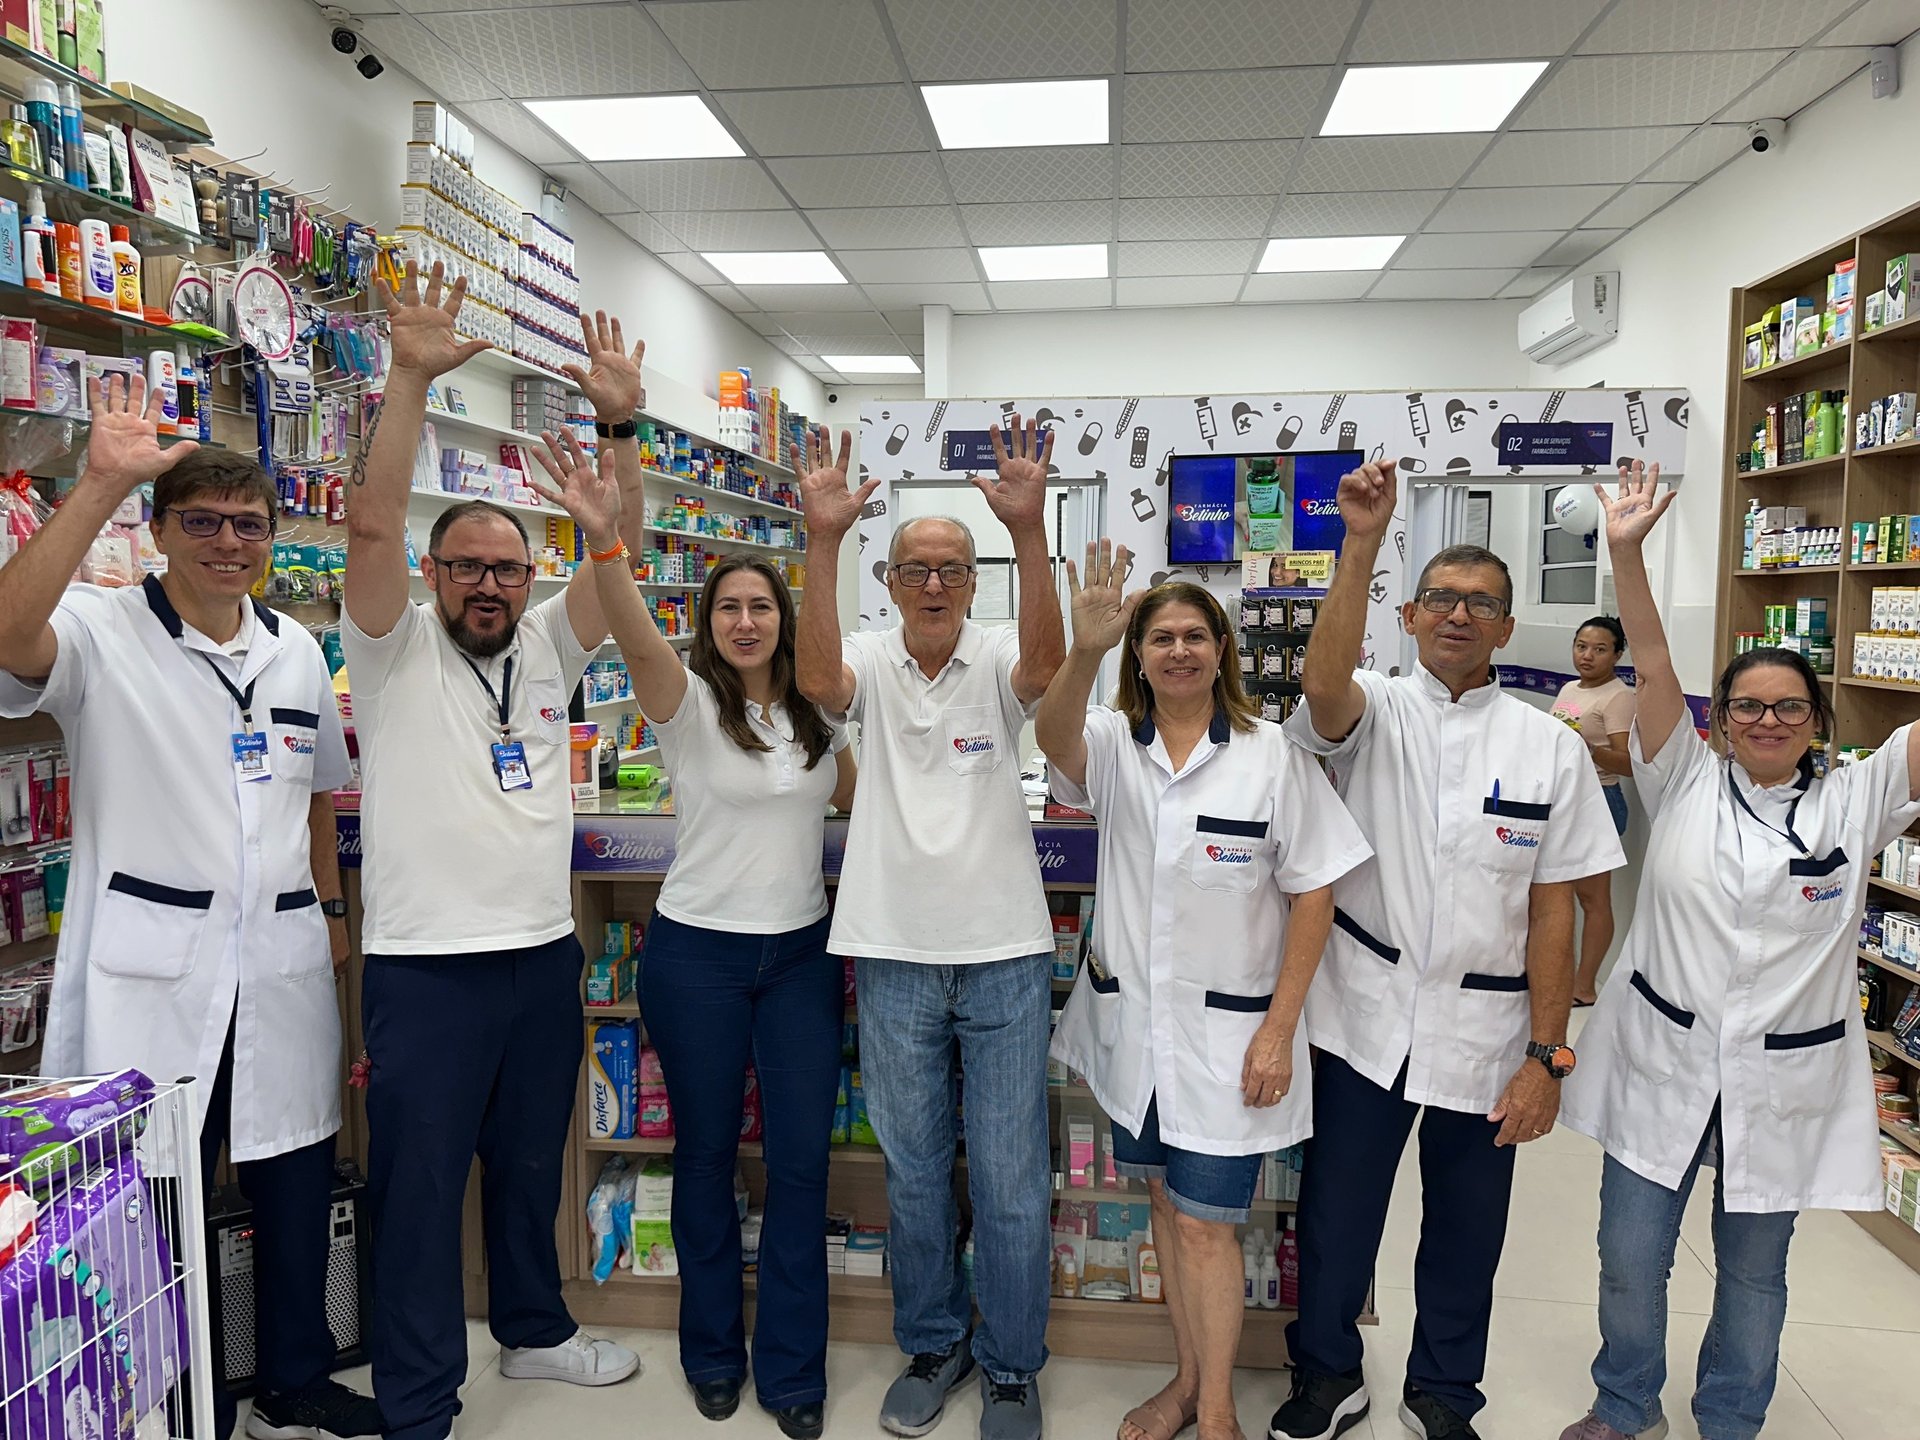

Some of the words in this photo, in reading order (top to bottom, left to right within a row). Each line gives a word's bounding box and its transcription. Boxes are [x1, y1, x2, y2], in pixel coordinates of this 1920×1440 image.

[953, 443, 966, 458] 01
[1506, 436, 1523, 452] 02
[1180, 505, 1231, 521] Betinho
[592, 835, 666, 860] Betinho
[588, 981, 599, 989] ob
[593, 1081, 609, 1133] Disfarce
